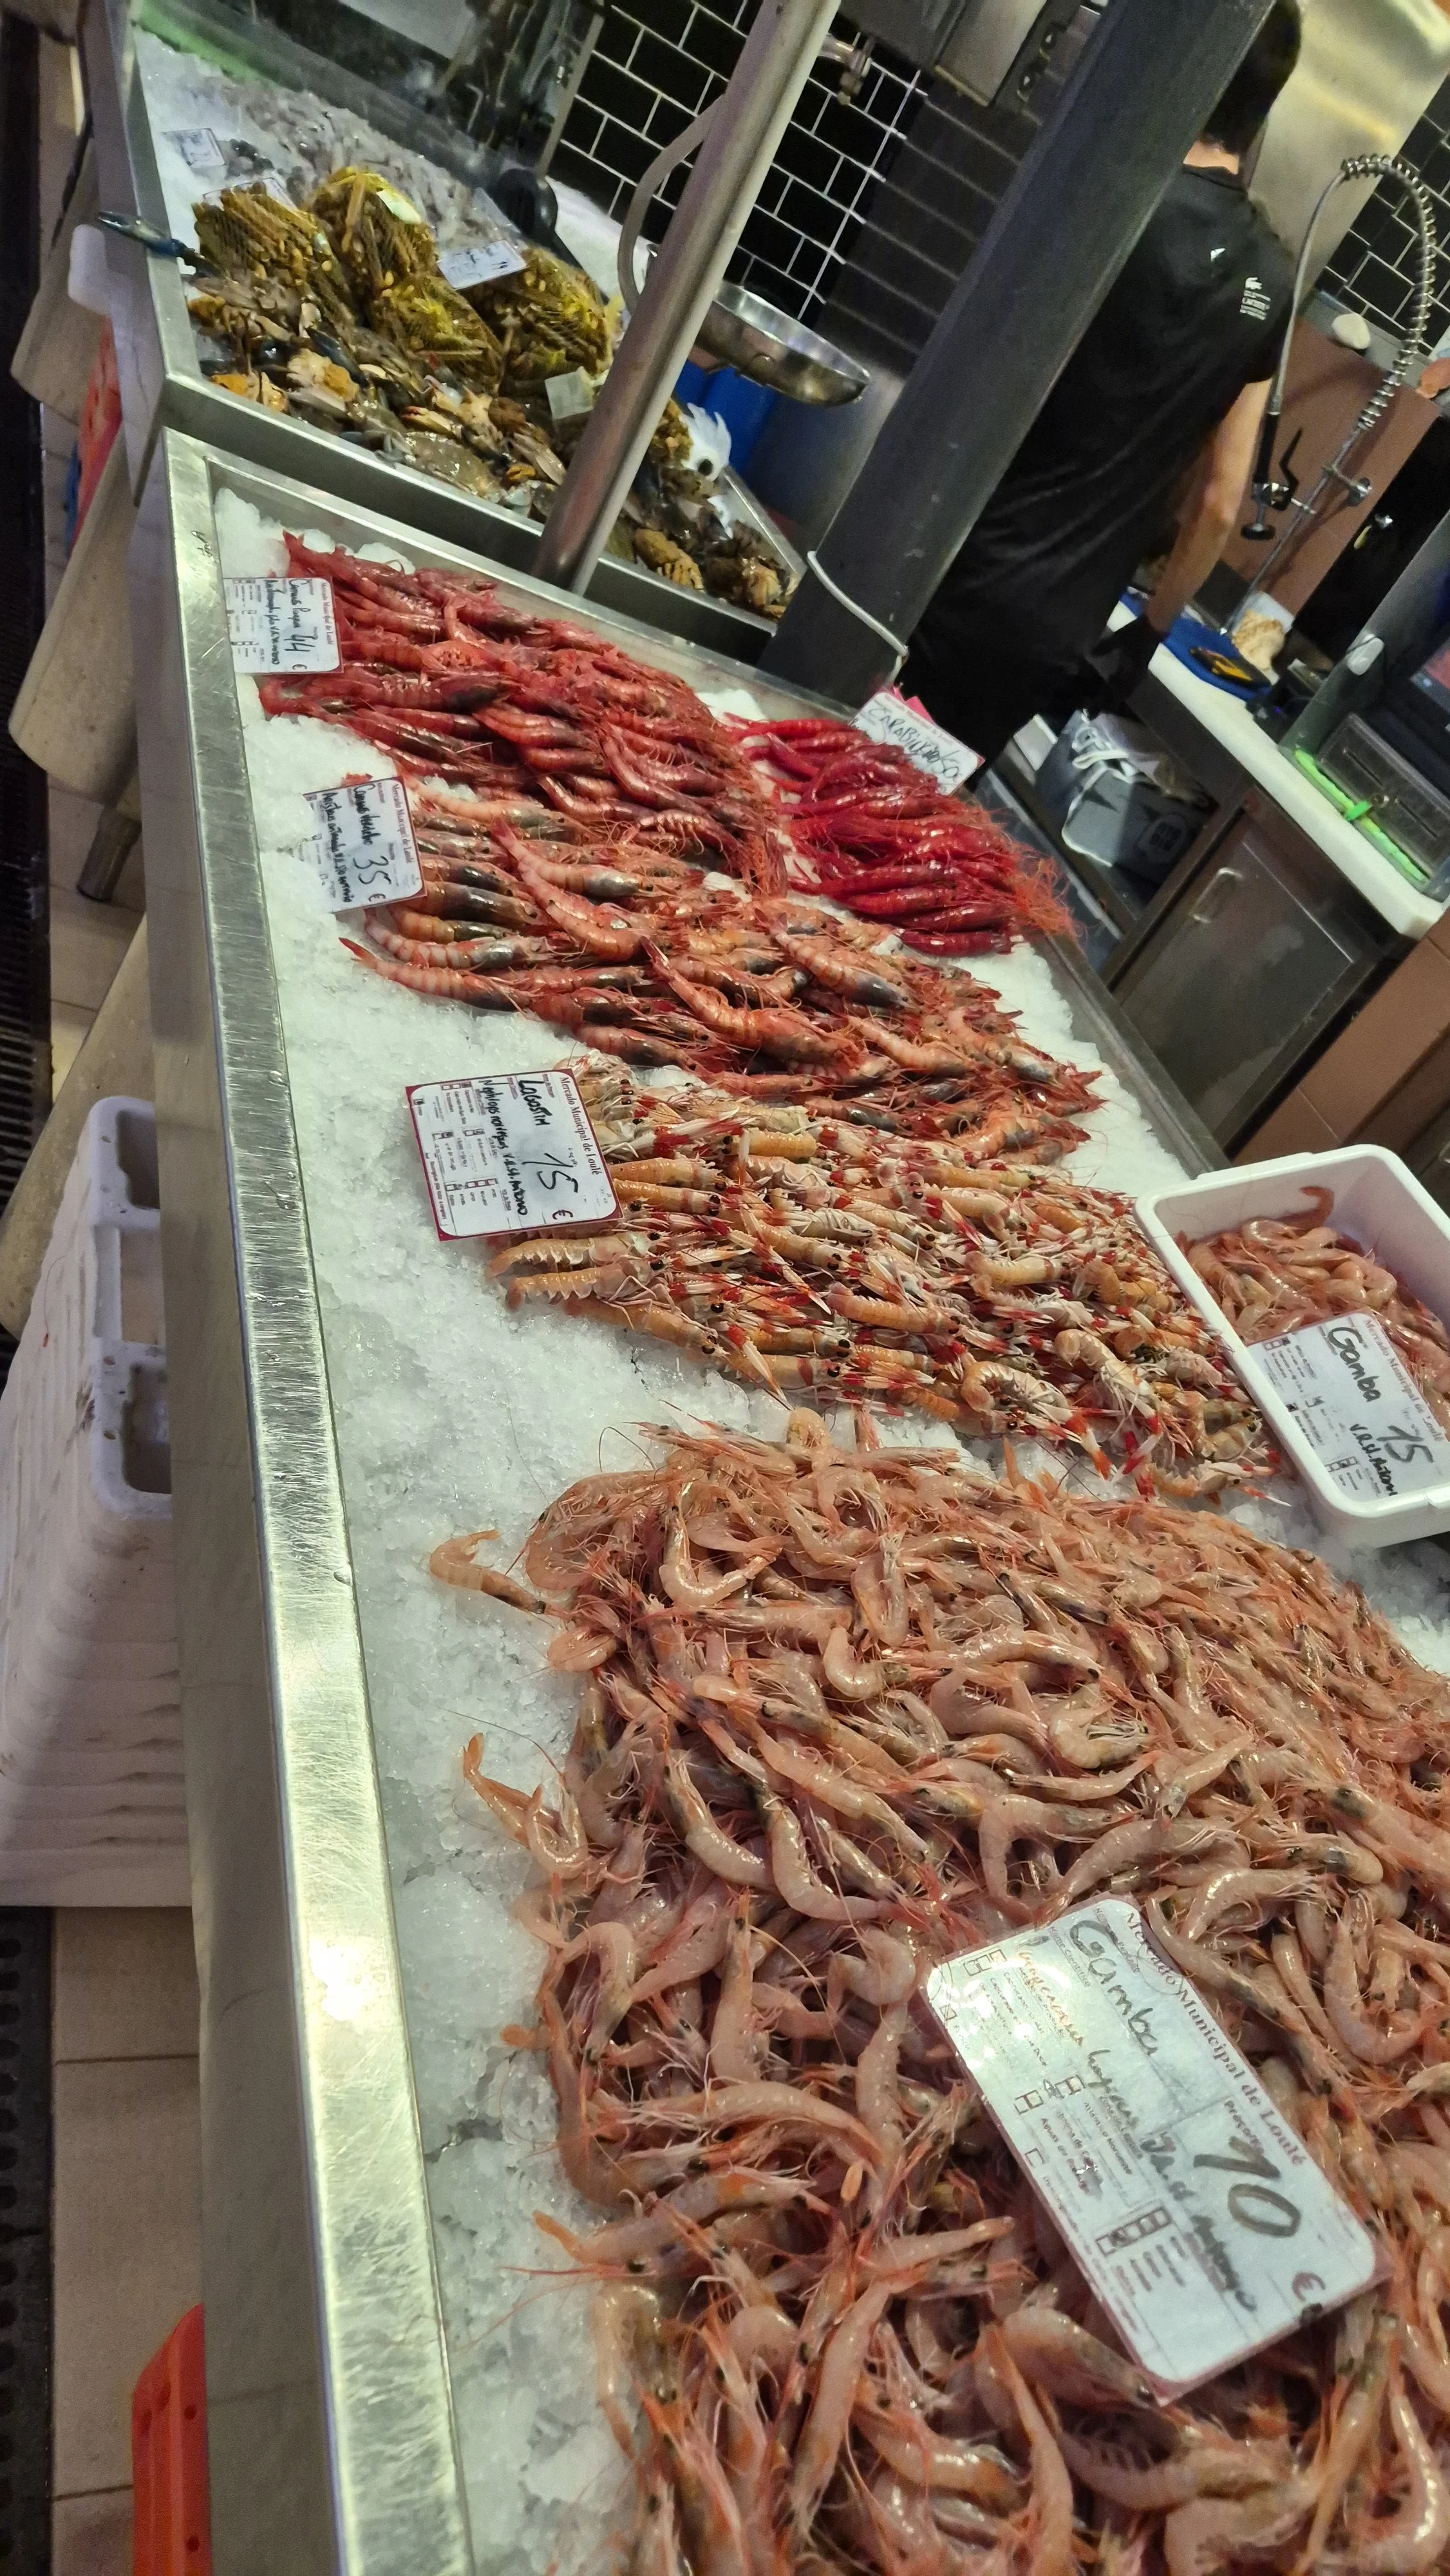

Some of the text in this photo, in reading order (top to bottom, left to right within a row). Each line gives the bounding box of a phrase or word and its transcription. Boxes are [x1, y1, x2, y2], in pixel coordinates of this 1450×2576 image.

[353, 855, 392, 902] 35 €
[558, 1077, 578, 1105] Mercado
[567, 1106, 591, 1141] Municipal
[581, 1142, 594, 1151] de
[522, 1153, 579, 1220] 15 €
[585, 1153, 603, 1175] Loulé
[1328, 1327, 1382, 1403] Gamba
[1377, 1425, 1434, 1463] 15
[1069, 1920, 1156, 2057] Gamba
[1123, 1911, 1308, 2168] Mercado Municipal de Loulé
[1194, 2136, 1303, 2237] 10
[1292, 2271, 1326, 2301] €
